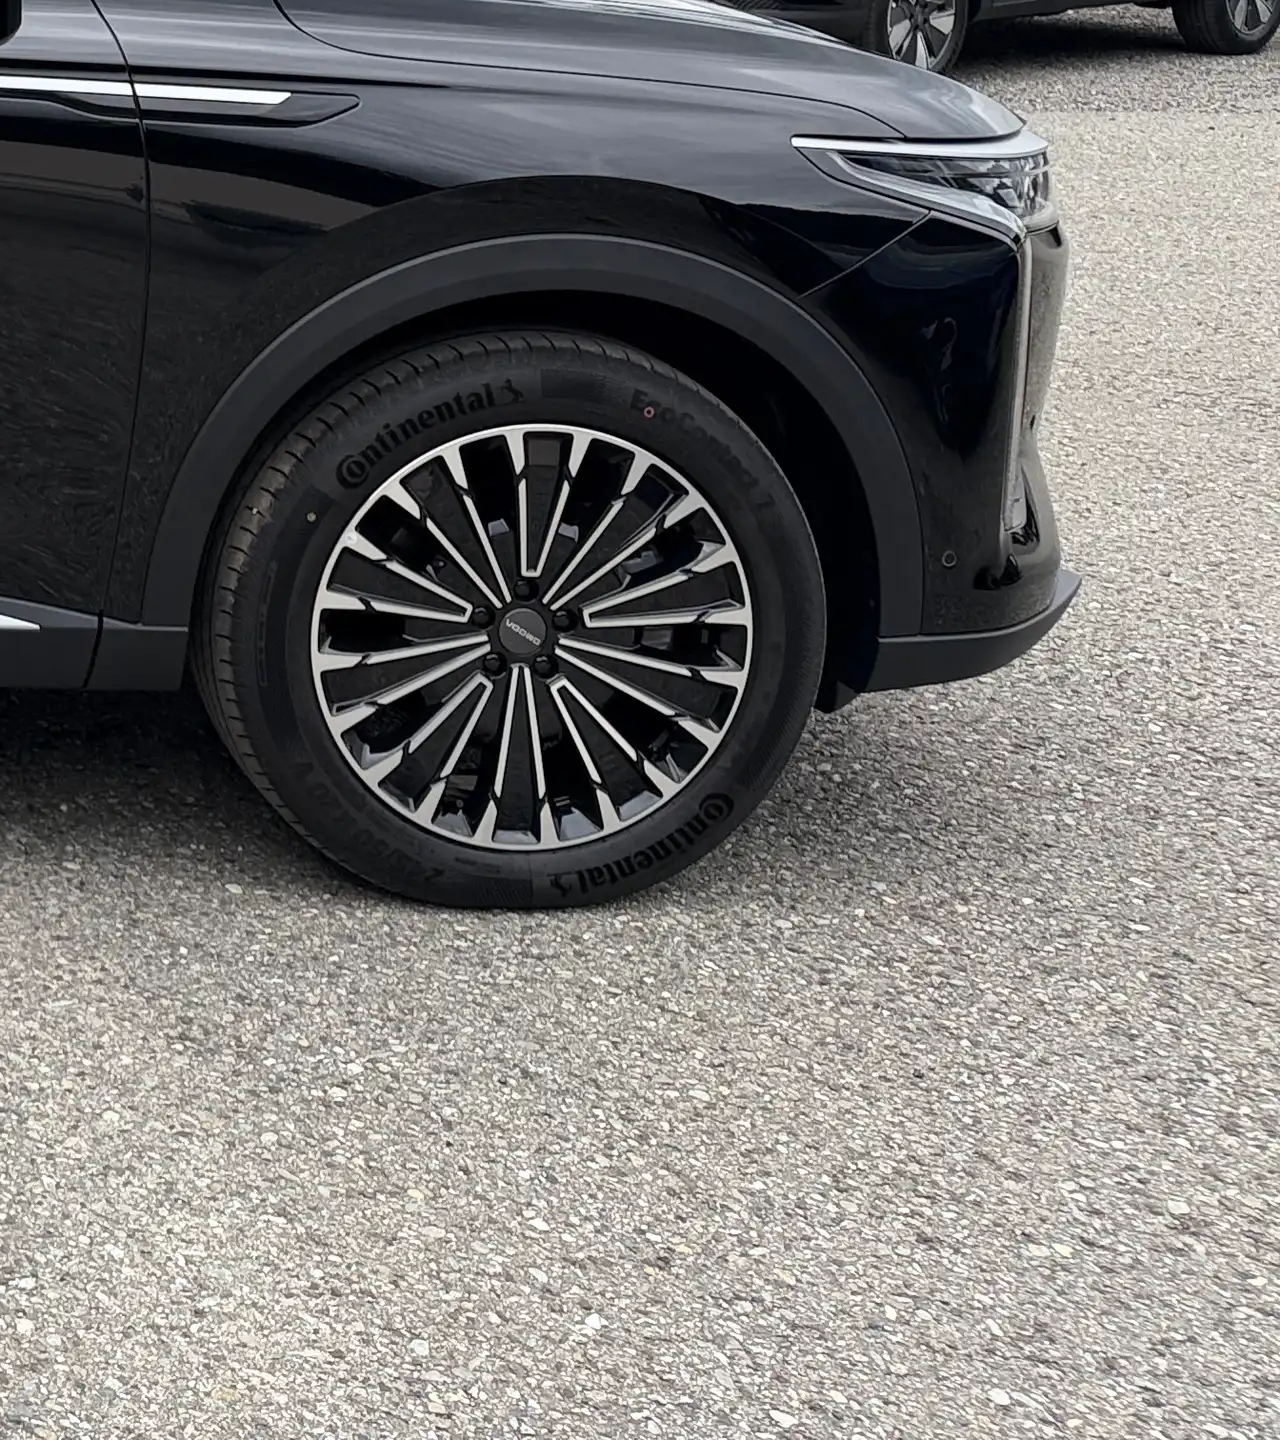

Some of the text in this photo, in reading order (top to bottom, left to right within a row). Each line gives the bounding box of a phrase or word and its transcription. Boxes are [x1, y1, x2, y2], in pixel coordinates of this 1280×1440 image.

[336, 383, 495, 491] Continental
[505, 618, 542, 647] OMODA
[575, 793, 734, 895] Continental
